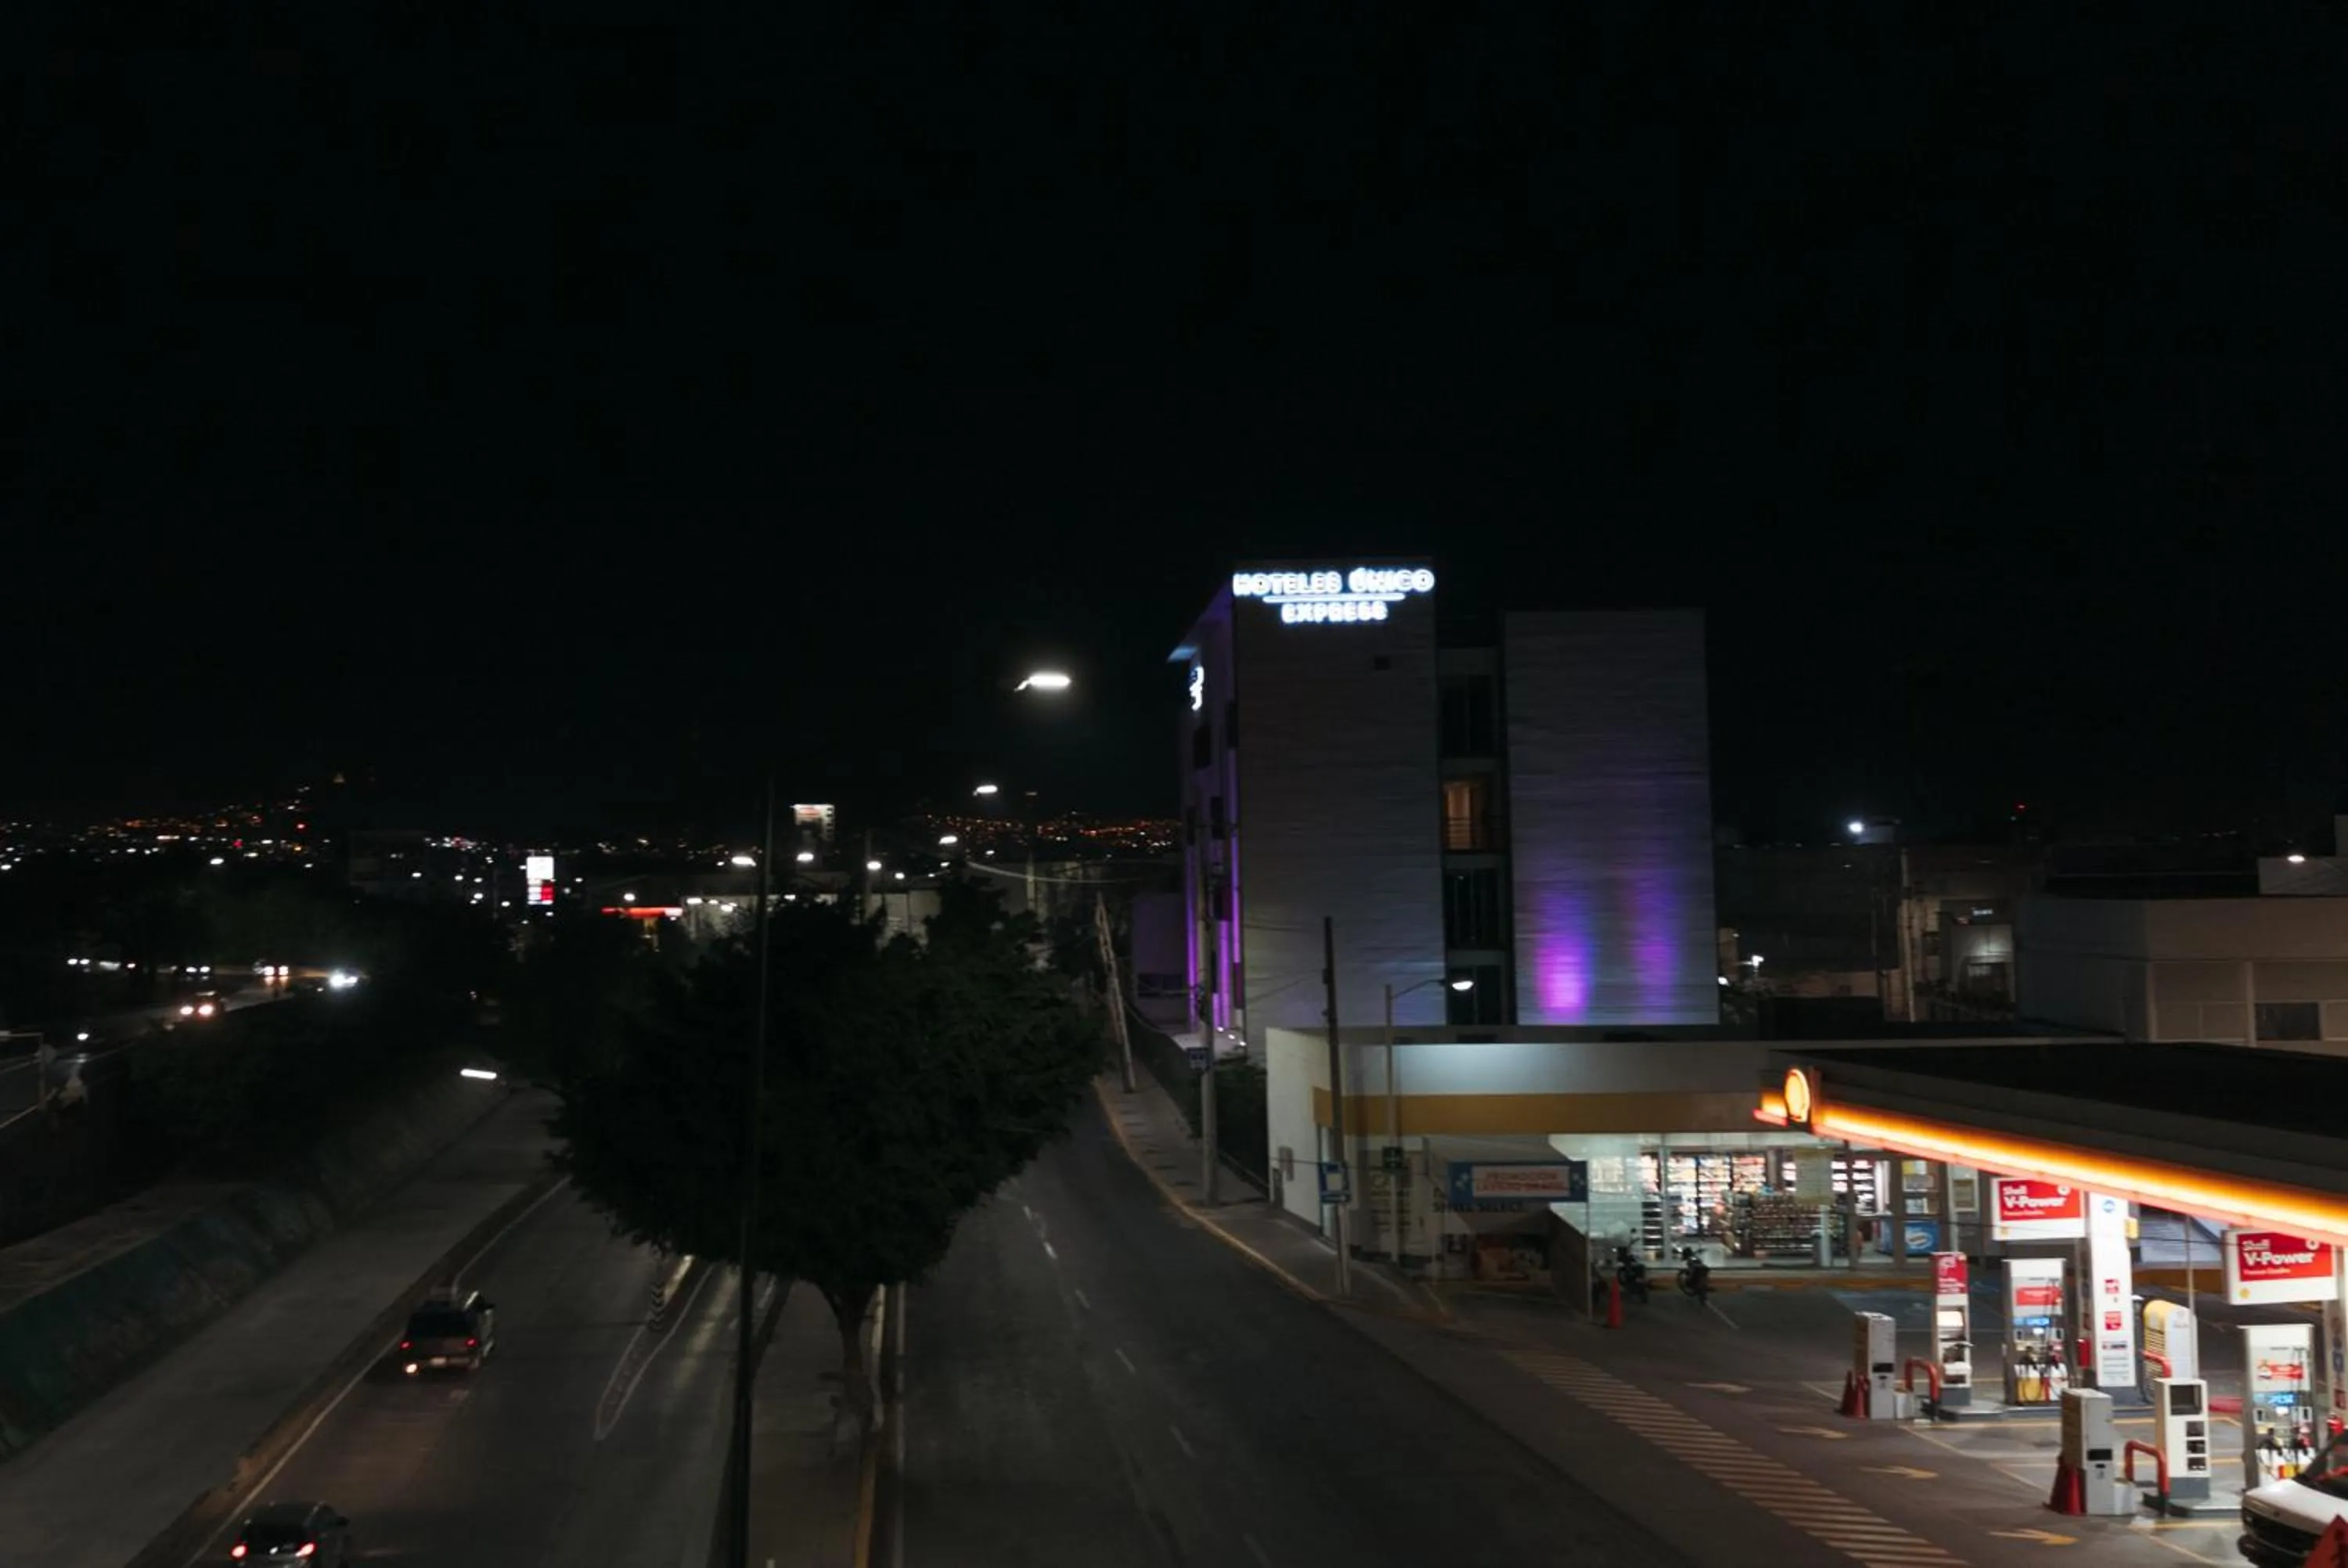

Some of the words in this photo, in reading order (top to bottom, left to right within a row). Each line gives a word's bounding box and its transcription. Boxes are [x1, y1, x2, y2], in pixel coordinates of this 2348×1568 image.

[1233, 572, 1343, 595] HOTELES
[1348, 567, 1435, 593] ÚNICO
[1281, 600, 1388, 623] EXPRESS
[2004, 1196, 2066, 1208] V-Power
[2242, 1239, 2270, 1250] Shell
[2243, 1252, 2315, 1265] V-Power
